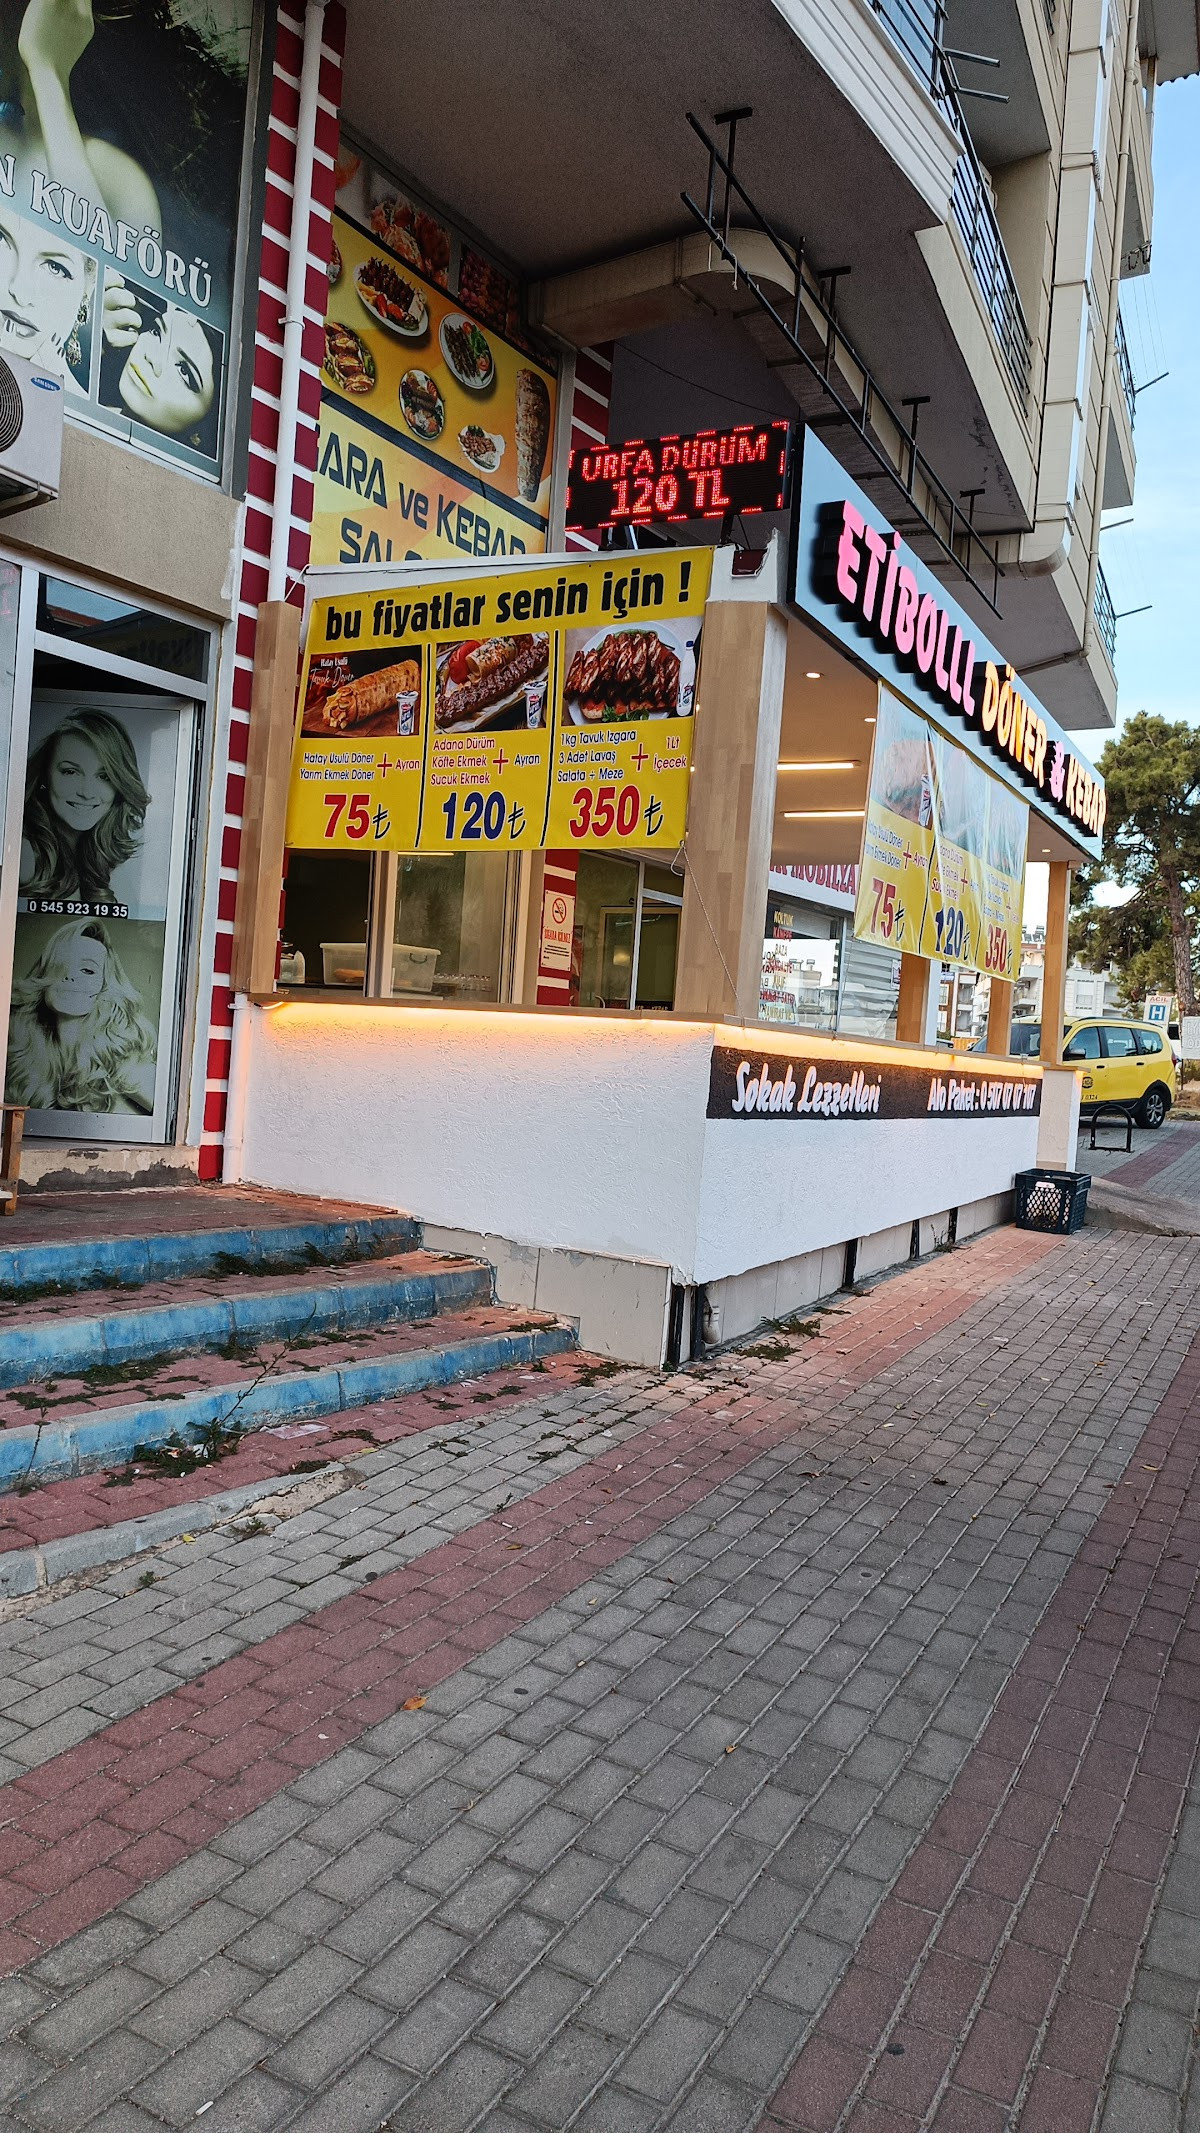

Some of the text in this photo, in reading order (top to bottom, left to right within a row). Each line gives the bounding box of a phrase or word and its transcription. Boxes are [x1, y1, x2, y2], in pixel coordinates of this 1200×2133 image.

[30, 169, 212, 307] KUAFÖRÜ
[581, 433, 768, 481] URFA DÜRÜM
[316, 424, 388, 509] ARA
[399, 482, 429, 530] ve
[610, 467, 730, 515] 120 TL
[325, 606, 362, 641] bu
[373, 592, 487, 638] fiyatlar
[495, 577, 590, 623] senin
[600, 567, 665, 619] için
[837, 500, 1107, 837] ETİBOLLL DÖNER & KEBAP
[433, 737, 495, 751] Adana Dürüm
[561, 730, 636, 747] 1kg Tavuk Izgara
[303, 752, 328, 765] Hatay
[329, 752, 349, 764] Usulü
[351, 752, 374, 764] Döner
[395, 759, 420, 772] Ayran
[432, 756, 455, 768] Köfte
[457, 755, 487, 768] Ekmek
[514, 754, 540, 767] Ayran
[559, 752, 564, 763] 3
[567, 751, 588, 763] Adet
[590, 750, 616, 764] Lavaş
[653, 755, 687, 772] İçecek
[324, 768, 349, 780] Ekmek
[351, 768, 375, 780] Döner
[431, 772, 490, 785] Sucuk Ekmek
[557, 770, 586, 782] Salata
[598, 768, 624, 780] Meze
[29, 901, 128, 917] 0 545 923 19 35
[732, 1061, 882, 1117] Sokak Lezzetleri
[927, 1077, 946, 1111] Alo
[980, 1080, 987, 1110] 0
